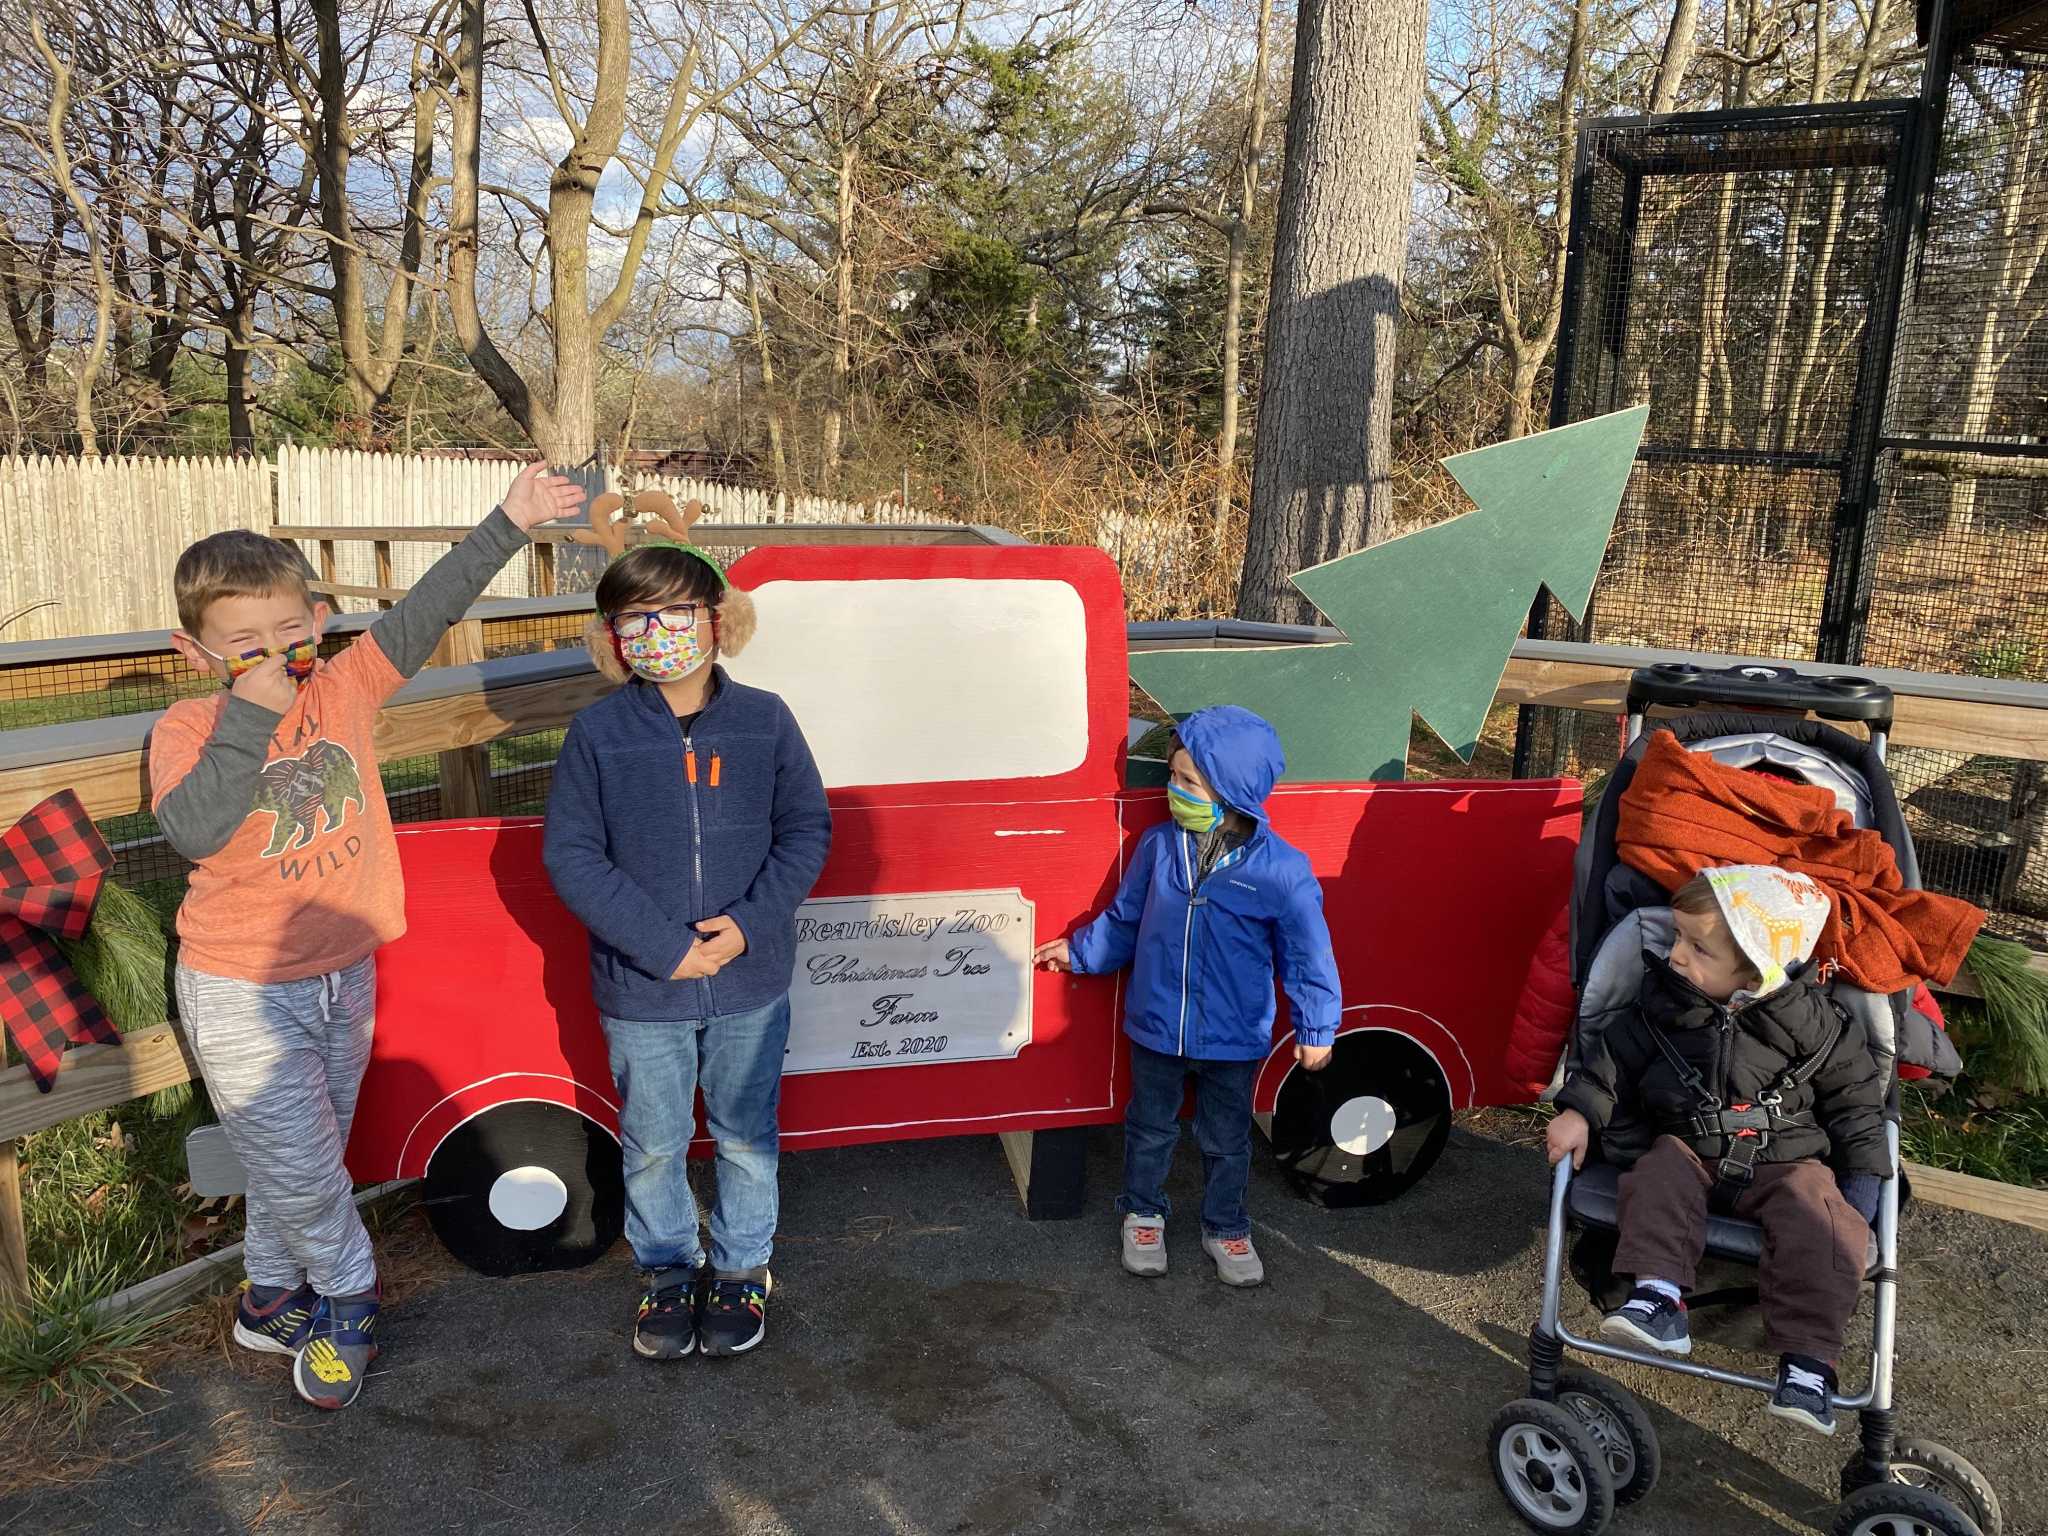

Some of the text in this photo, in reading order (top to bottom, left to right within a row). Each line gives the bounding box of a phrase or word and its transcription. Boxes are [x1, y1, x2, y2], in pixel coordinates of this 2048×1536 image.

[272, 714, 319, 753] TAY
[280, 835, 361, 881] WILD
[796, 909, 1010, 943] Beardsley Zoo
[806, 945, 991, 986] Christmas Tree
[860, 993, 939, 1028] Farm
[851, 1035, 948, 1058] Est. 2020
